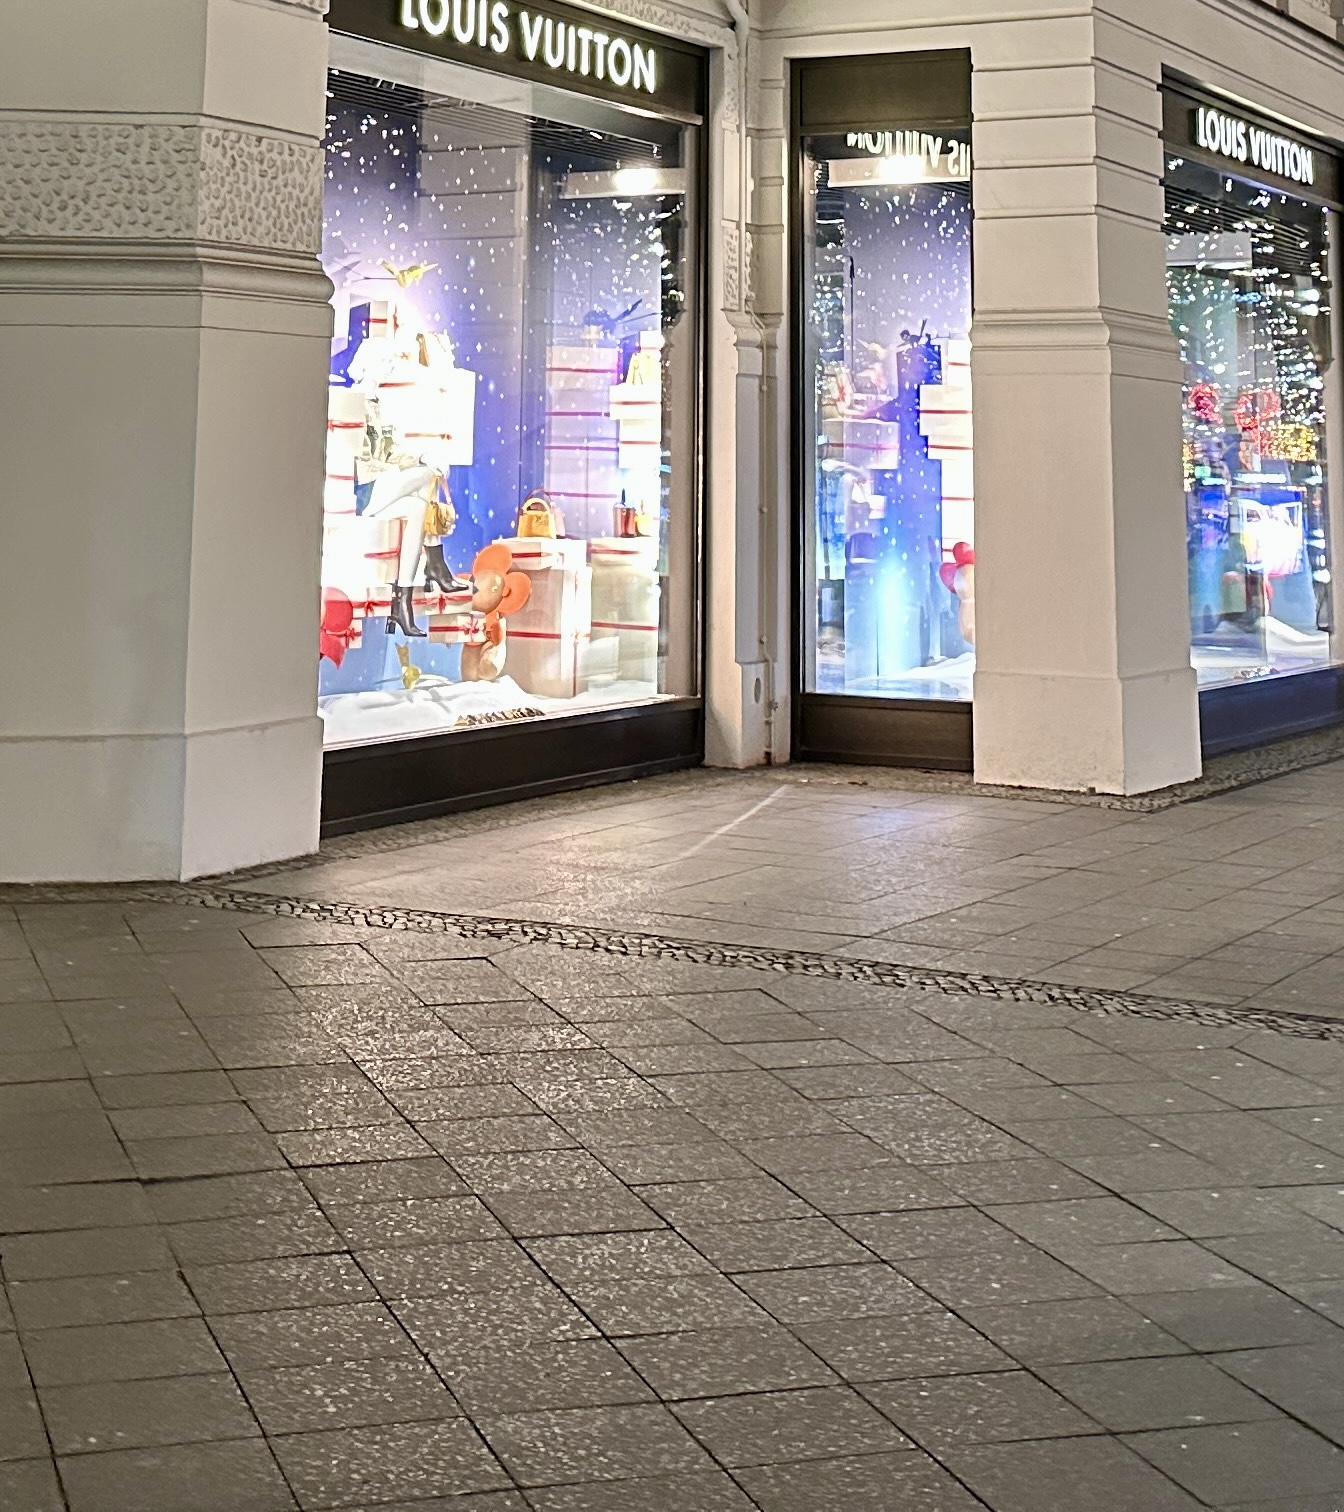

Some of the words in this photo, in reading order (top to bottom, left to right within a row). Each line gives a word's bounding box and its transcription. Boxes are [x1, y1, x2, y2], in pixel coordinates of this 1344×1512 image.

[520, 10, 656, 94] VUITTON
[1197, 107, 1247, 162] LOUIS
[1248, 126, 1314, 185] VUITTON
